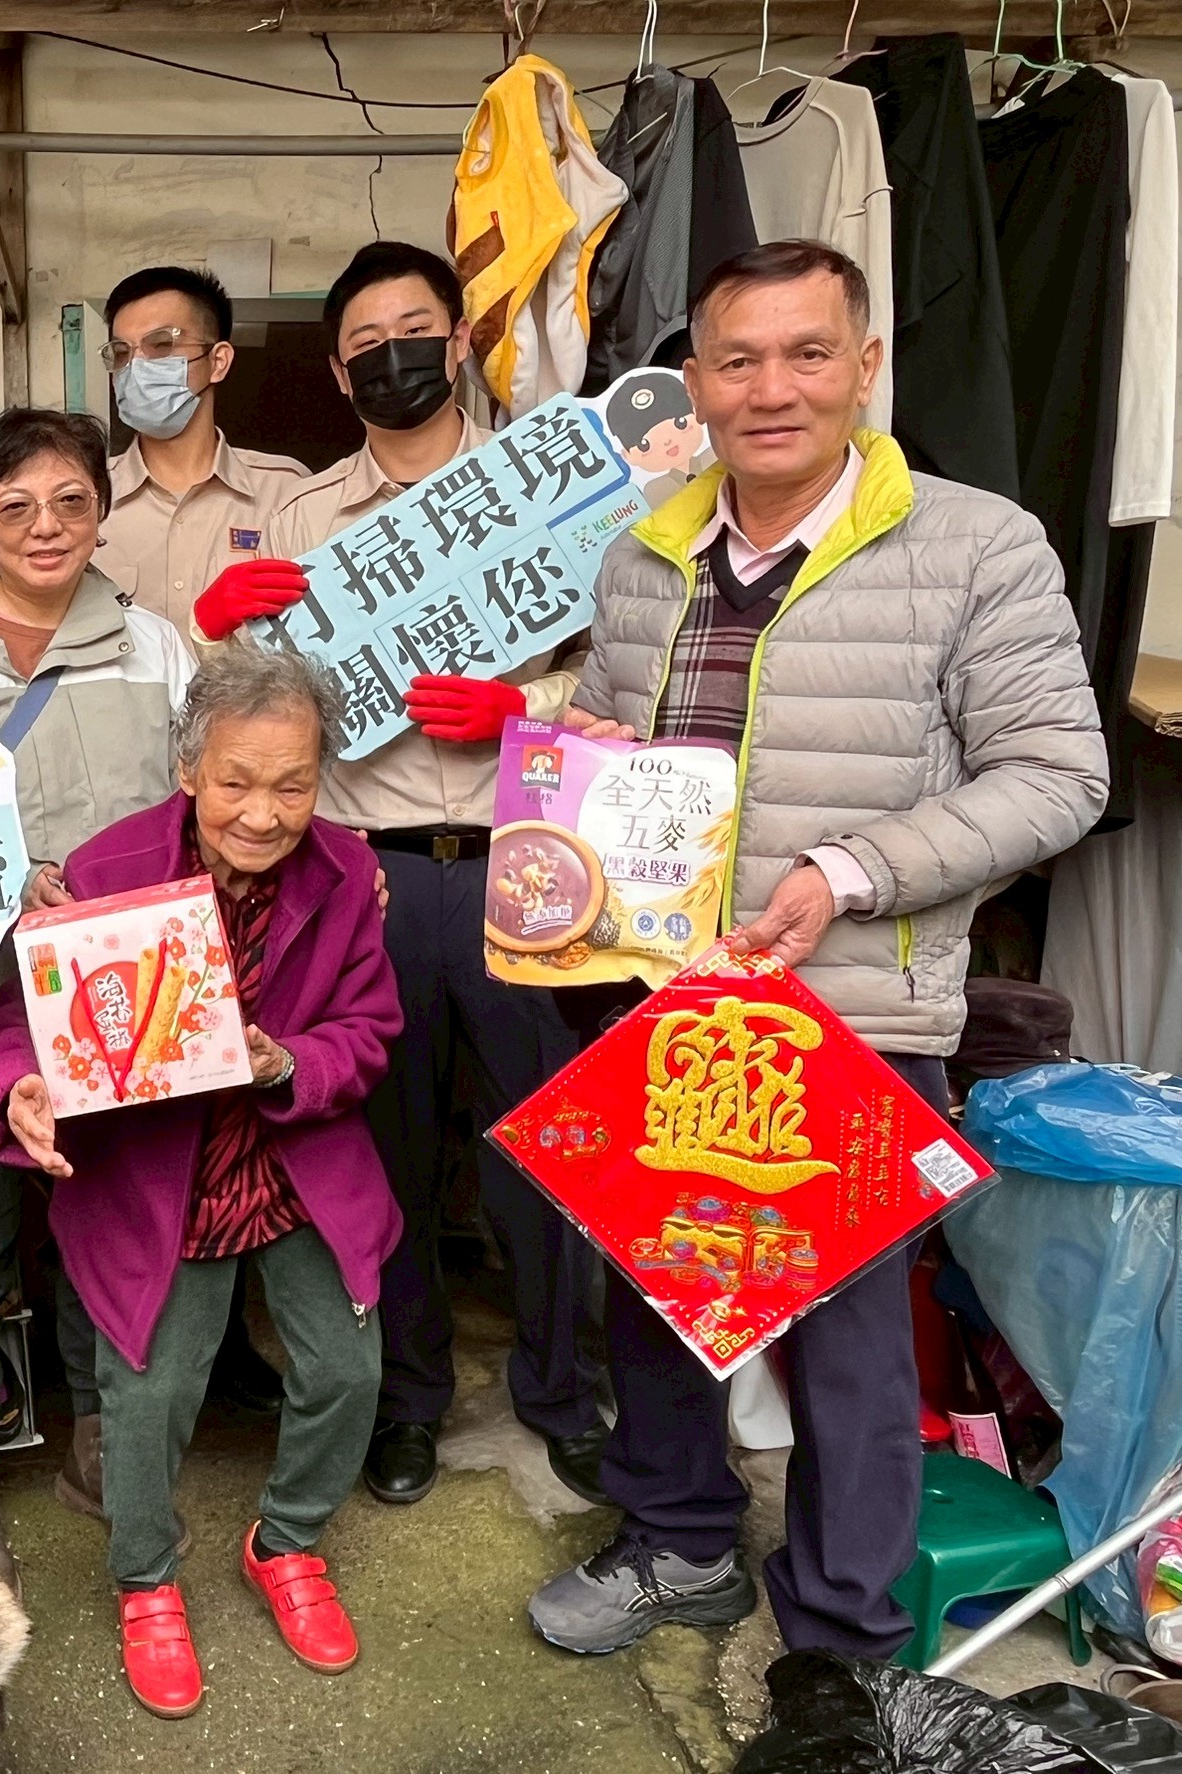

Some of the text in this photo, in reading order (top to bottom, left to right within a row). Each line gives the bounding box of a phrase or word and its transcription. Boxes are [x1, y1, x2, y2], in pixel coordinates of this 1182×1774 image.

[592, 499, 639, 533] KEELUNG
[338, 546, 582, 749] 關懷您
[522, 771, 560, 784] QUAKER
[629, 756, 673, 776] 100
[599, 774, 713, 816] 全天然
[616, 813, 687, 855] 五麥
[606, 856, 688, 883] 黑穀堅果
